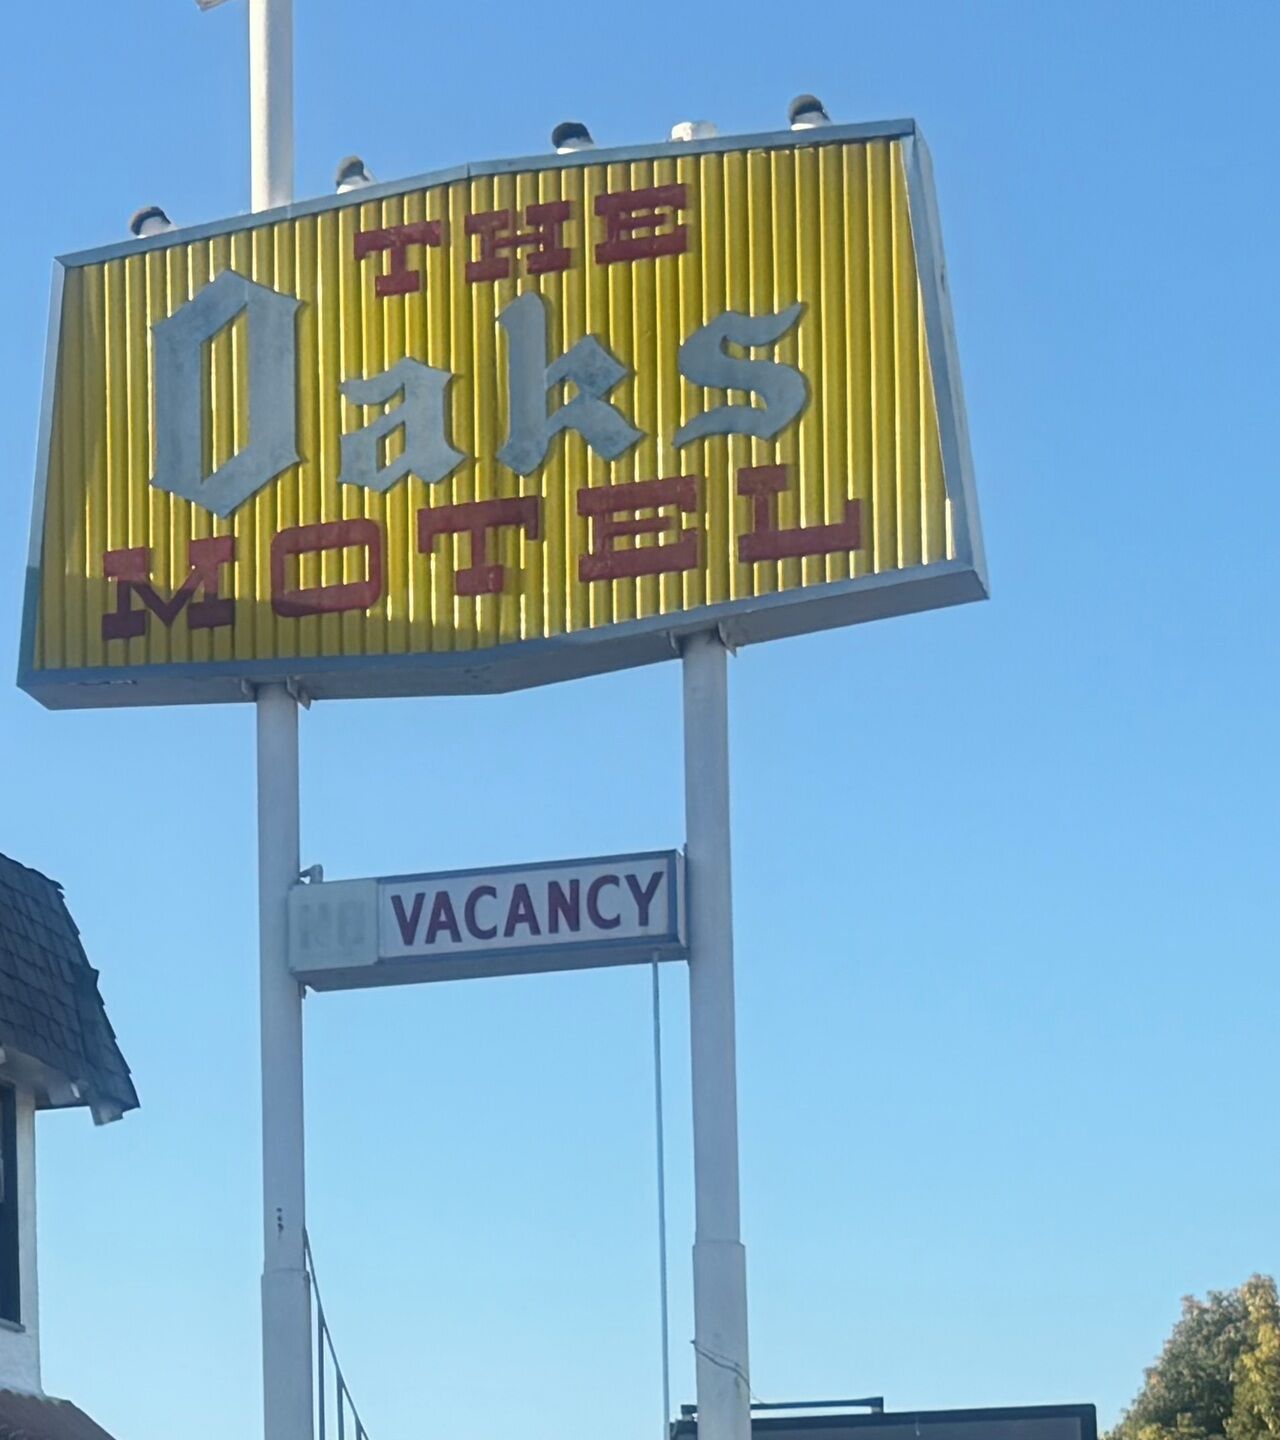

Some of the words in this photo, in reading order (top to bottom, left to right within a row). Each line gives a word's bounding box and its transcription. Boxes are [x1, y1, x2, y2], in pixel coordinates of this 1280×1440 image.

[353, 182, 689, 297] THE
[150, 269, 811, 517] Oaks
[102, 463, 861, 640] MOTEL
[390, 870, 665, 946] VACANCY
